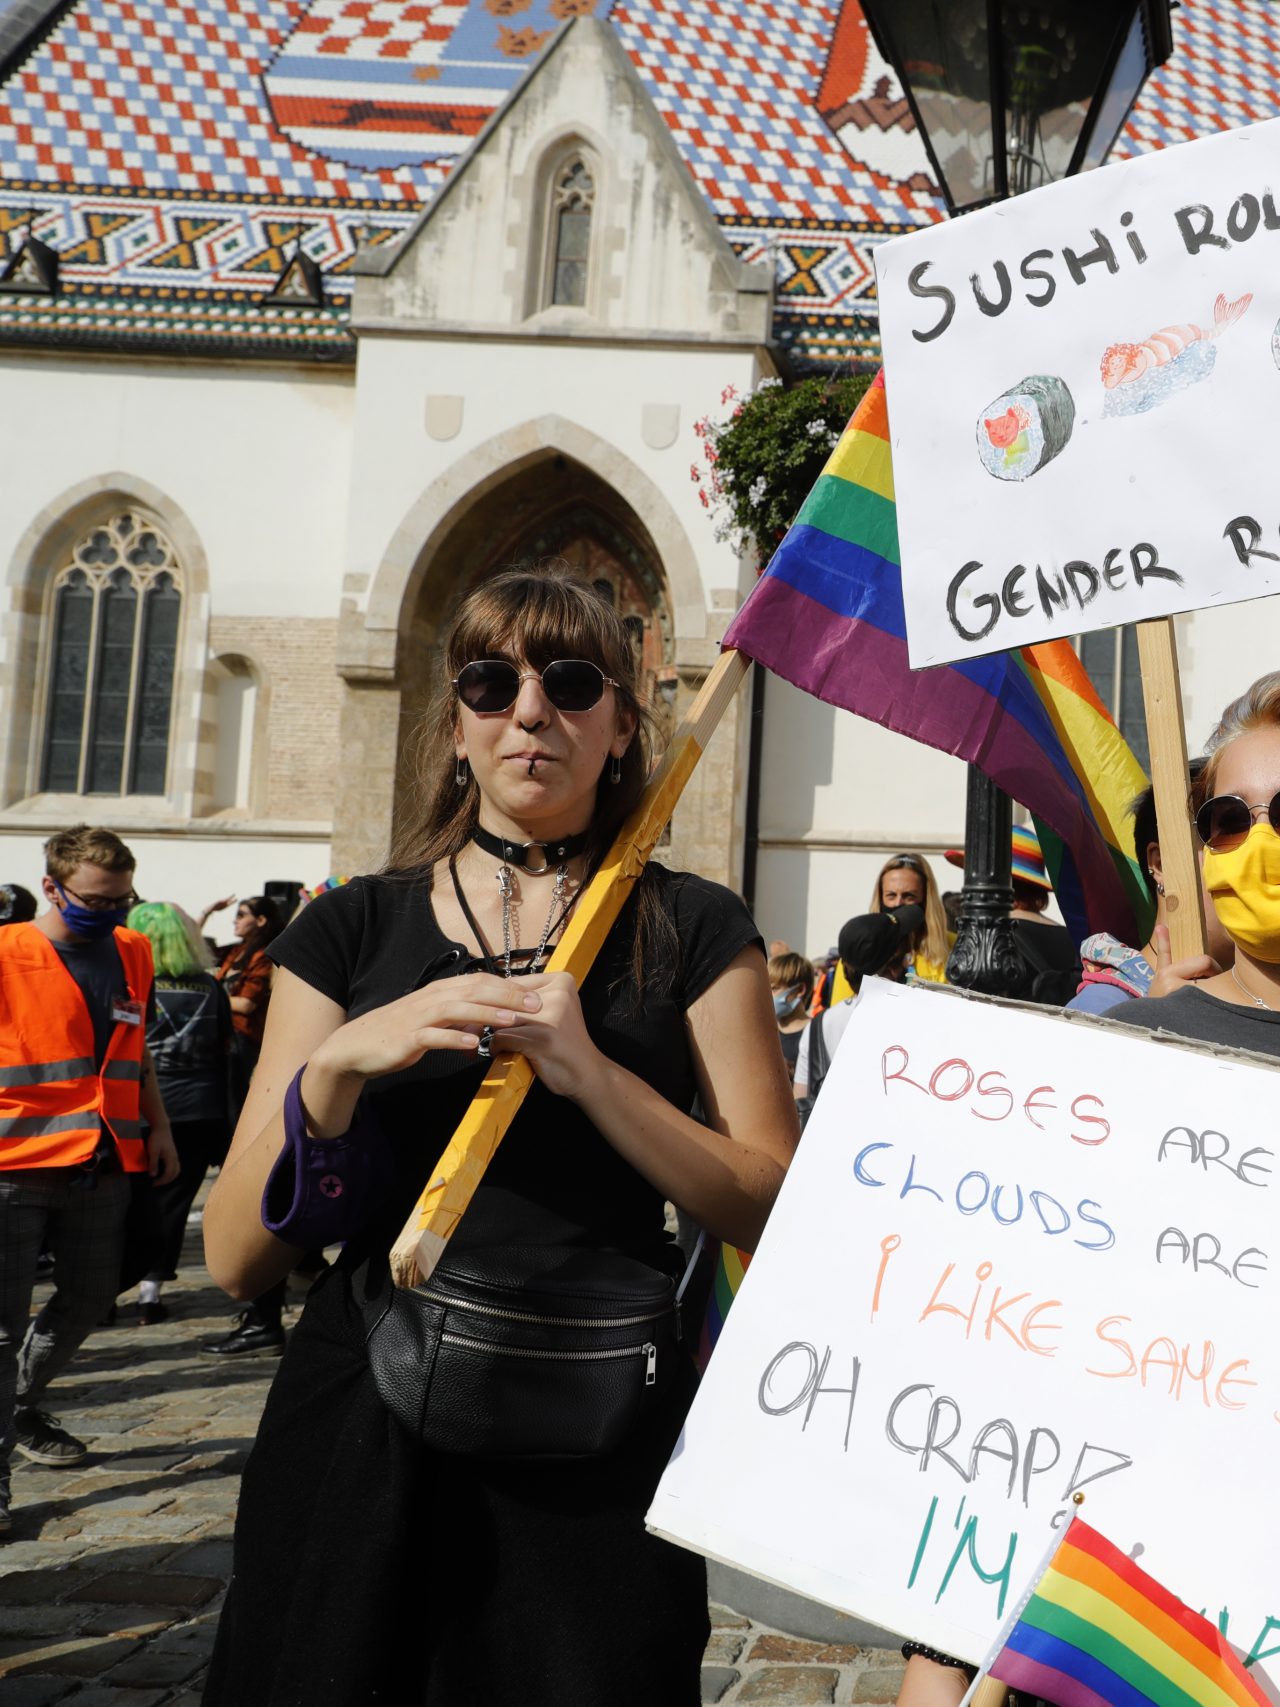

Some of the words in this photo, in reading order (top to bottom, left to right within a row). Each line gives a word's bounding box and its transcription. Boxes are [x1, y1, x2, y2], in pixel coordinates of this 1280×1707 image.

[946, 542, 1185, 642] GENDER
[880, 1045, 1112, 1146] ROSES
[1158, 1125, 1273, 1188] ARE
[852, 1143, 1116, 1251] CLOUDS
[1155, 1227, 1269, 1288] ARE
[757, 1341, 862, 1452] OH
[1085, 1316, 1258, 1411] SAME
[907, 1495, 1018, 1620] I'M
